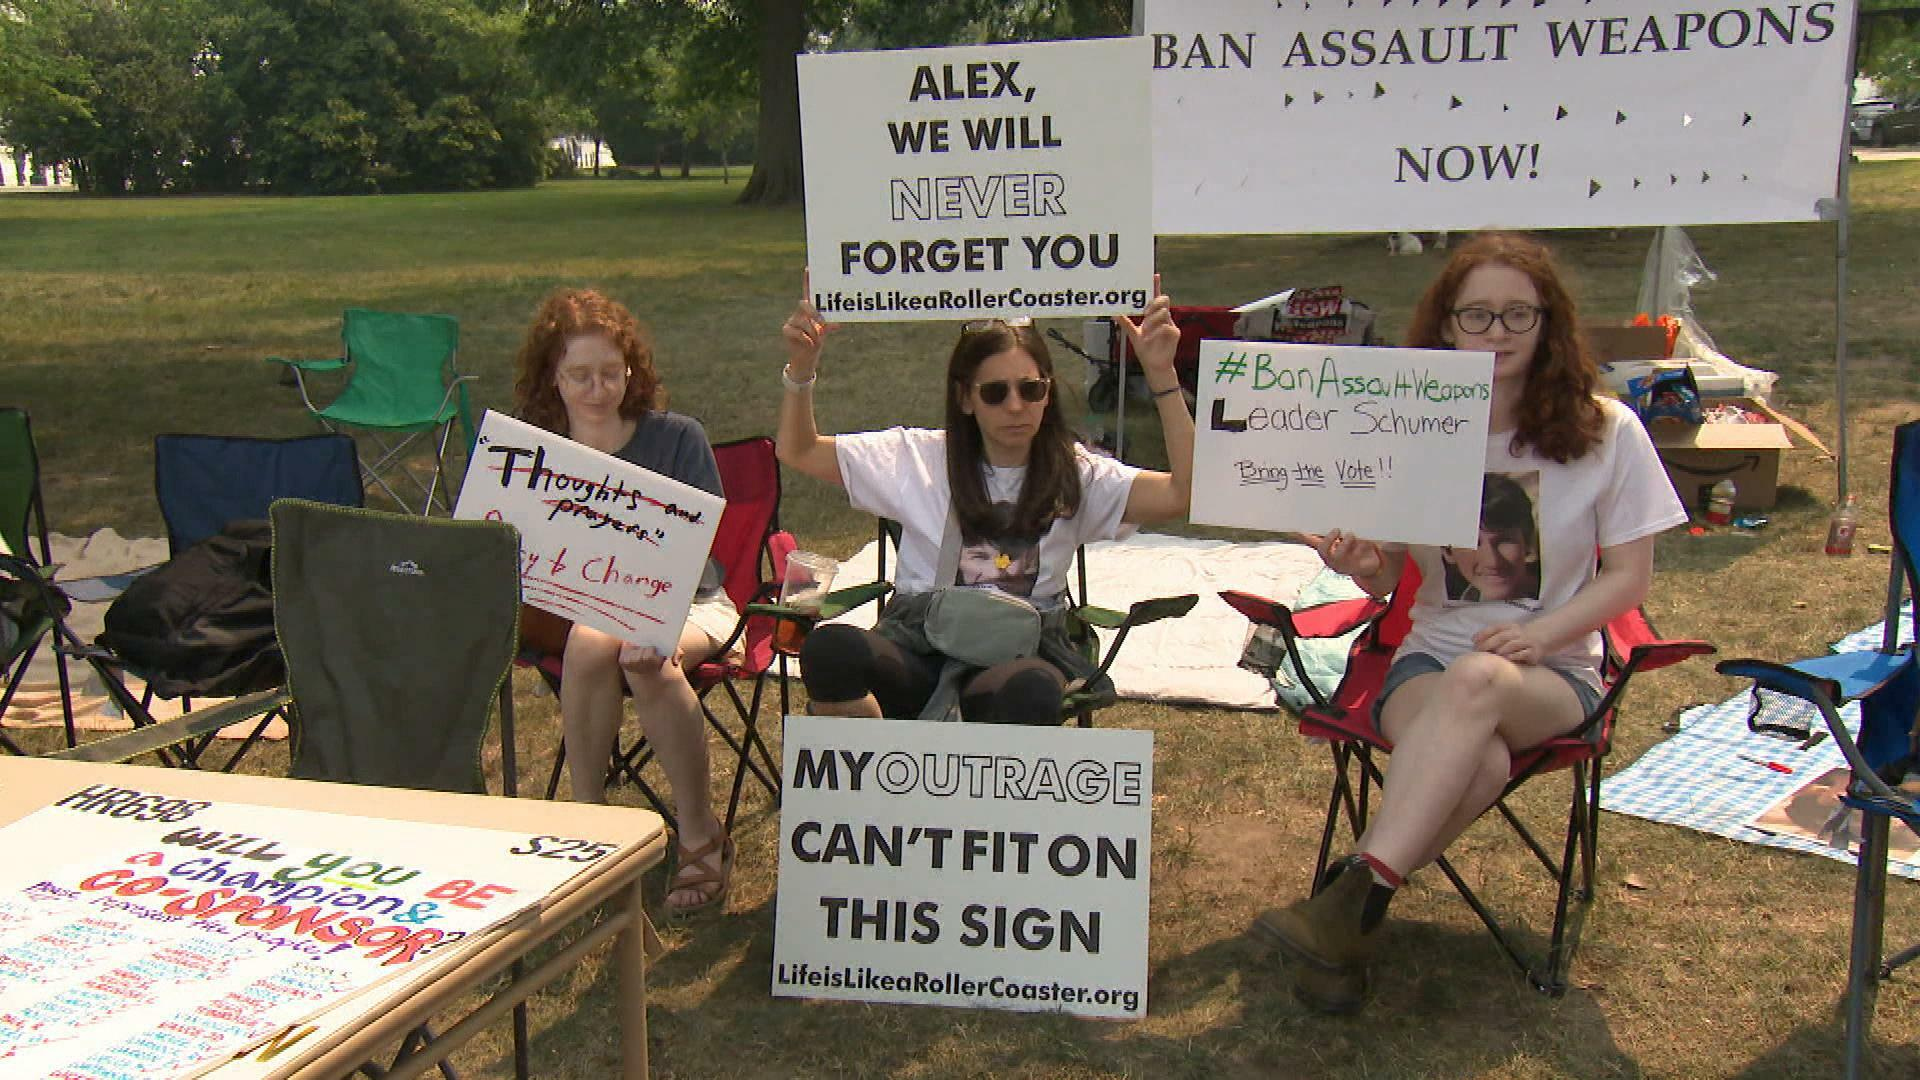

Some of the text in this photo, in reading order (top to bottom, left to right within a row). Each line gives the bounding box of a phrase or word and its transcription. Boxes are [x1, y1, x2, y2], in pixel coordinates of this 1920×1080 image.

[1151, 2, 1836, 69] BAN ASSAULT WEAPONS
[909, 61, 1036, 102] ALEX,
[888, 115, 1062, 154] WE WILL
[1394, 143, 1540, 183] NOW!
[890, 173, 1067, 221] NEVER
[840, 233, 1119, 275] FORGET YOU
[815, 288, 1147, 314] LifeisLikeaRollerCoaster.org
[1211, 397, 1469, 434] Leader Schumer
[1234, 455, 1392, 490] Bring the Vote!!
[582, 556, 673, 598] Change
[793, 749, 1142, 807] MY OUTRAGE
[509, 835, 618, 862] S25
[791, 821, 1138, 880] CAN'T FIT ON
[391, 901, 445, 925] &
[424, 879, 519, 910] BE
[820, 895, 1101, 955] THIS SIGN
[777, 963, 1140, 1012] LifeisLikeaRollerCoaster.org
